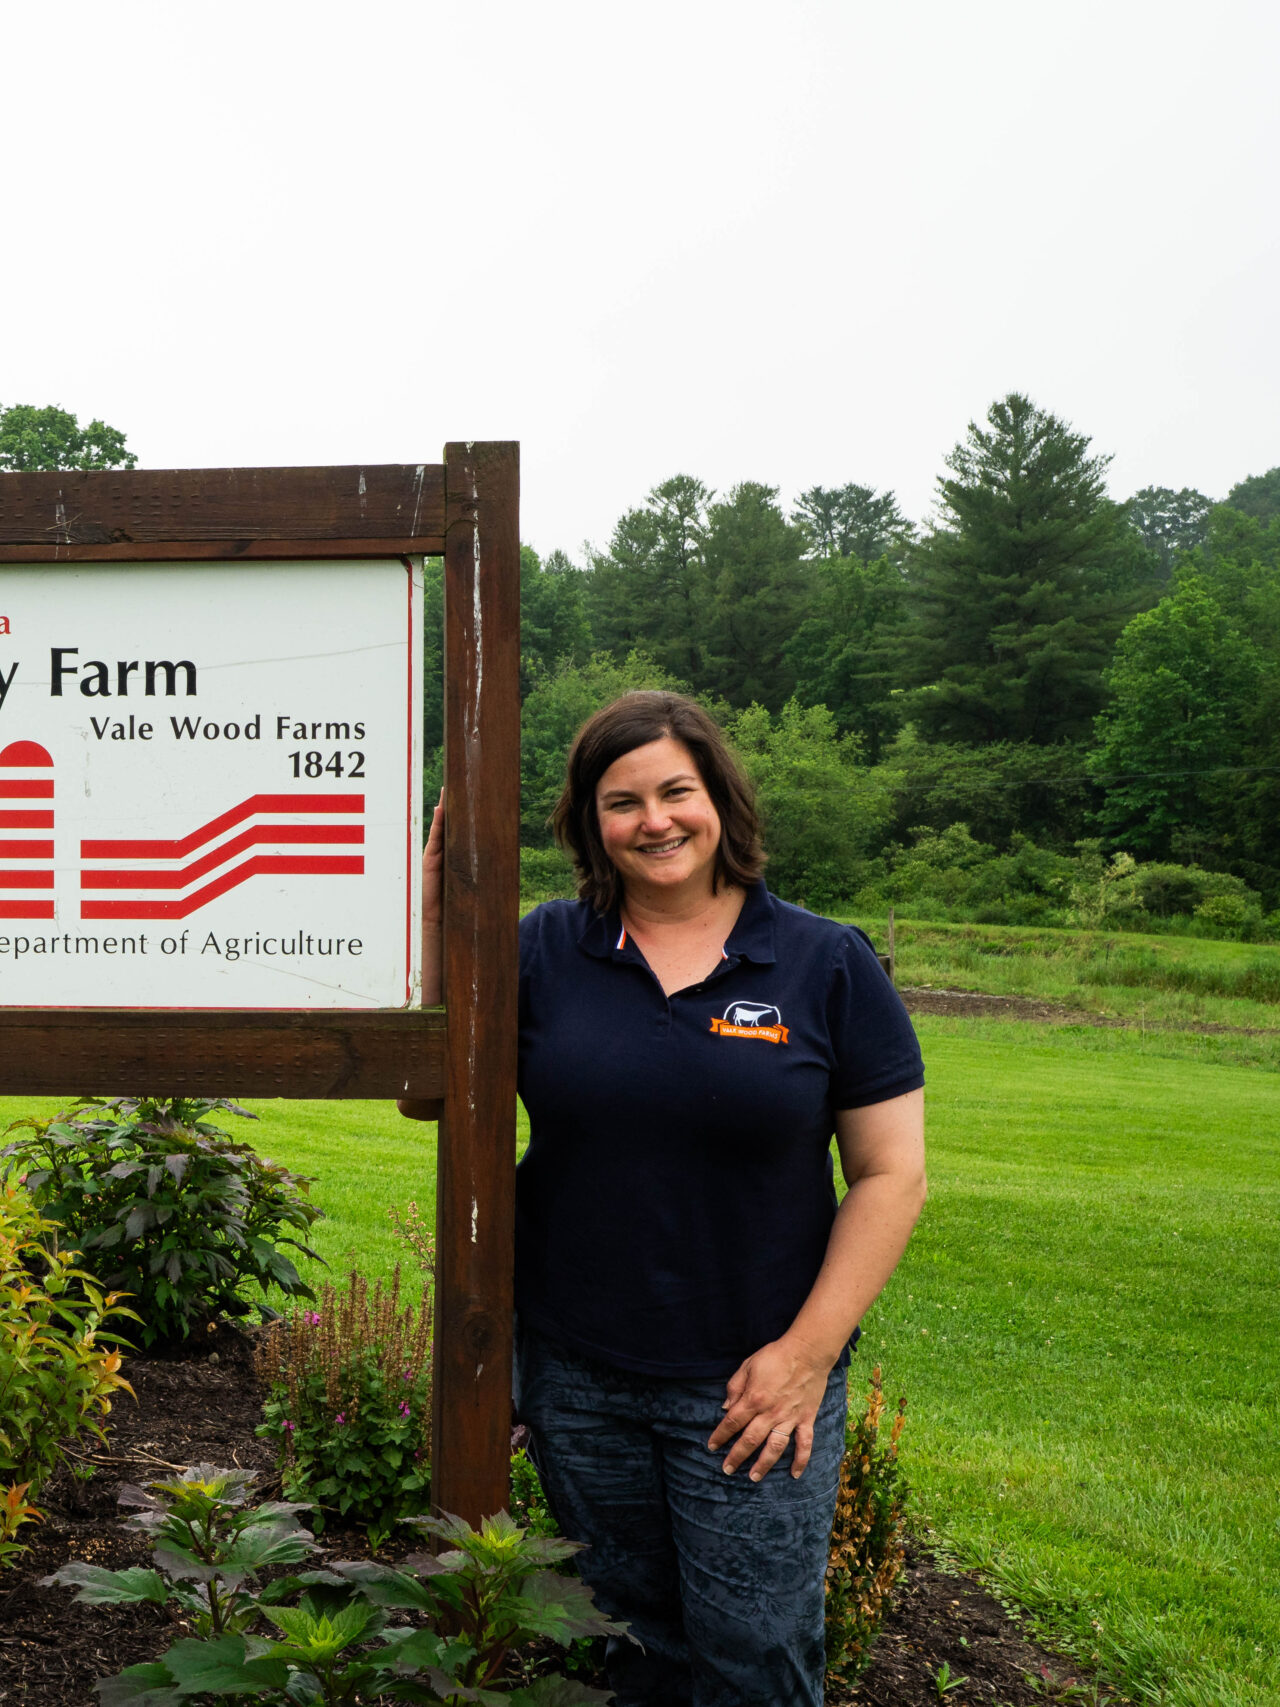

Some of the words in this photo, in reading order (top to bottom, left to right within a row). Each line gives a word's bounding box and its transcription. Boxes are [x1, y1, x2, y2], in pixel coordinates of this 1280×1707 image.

[50, 647, 197, 698] Farm
[89, 714, 154, 741] Vale
[169, 714, 261, 741] Wood
[276, 716, 366, 740] Farms
[287, 750, 366, 779] 1842
[160, 929, 189, 955] of
[200, 929, 363, 961] Agriculture
[758, 1029, 778, 1040] FARMS
